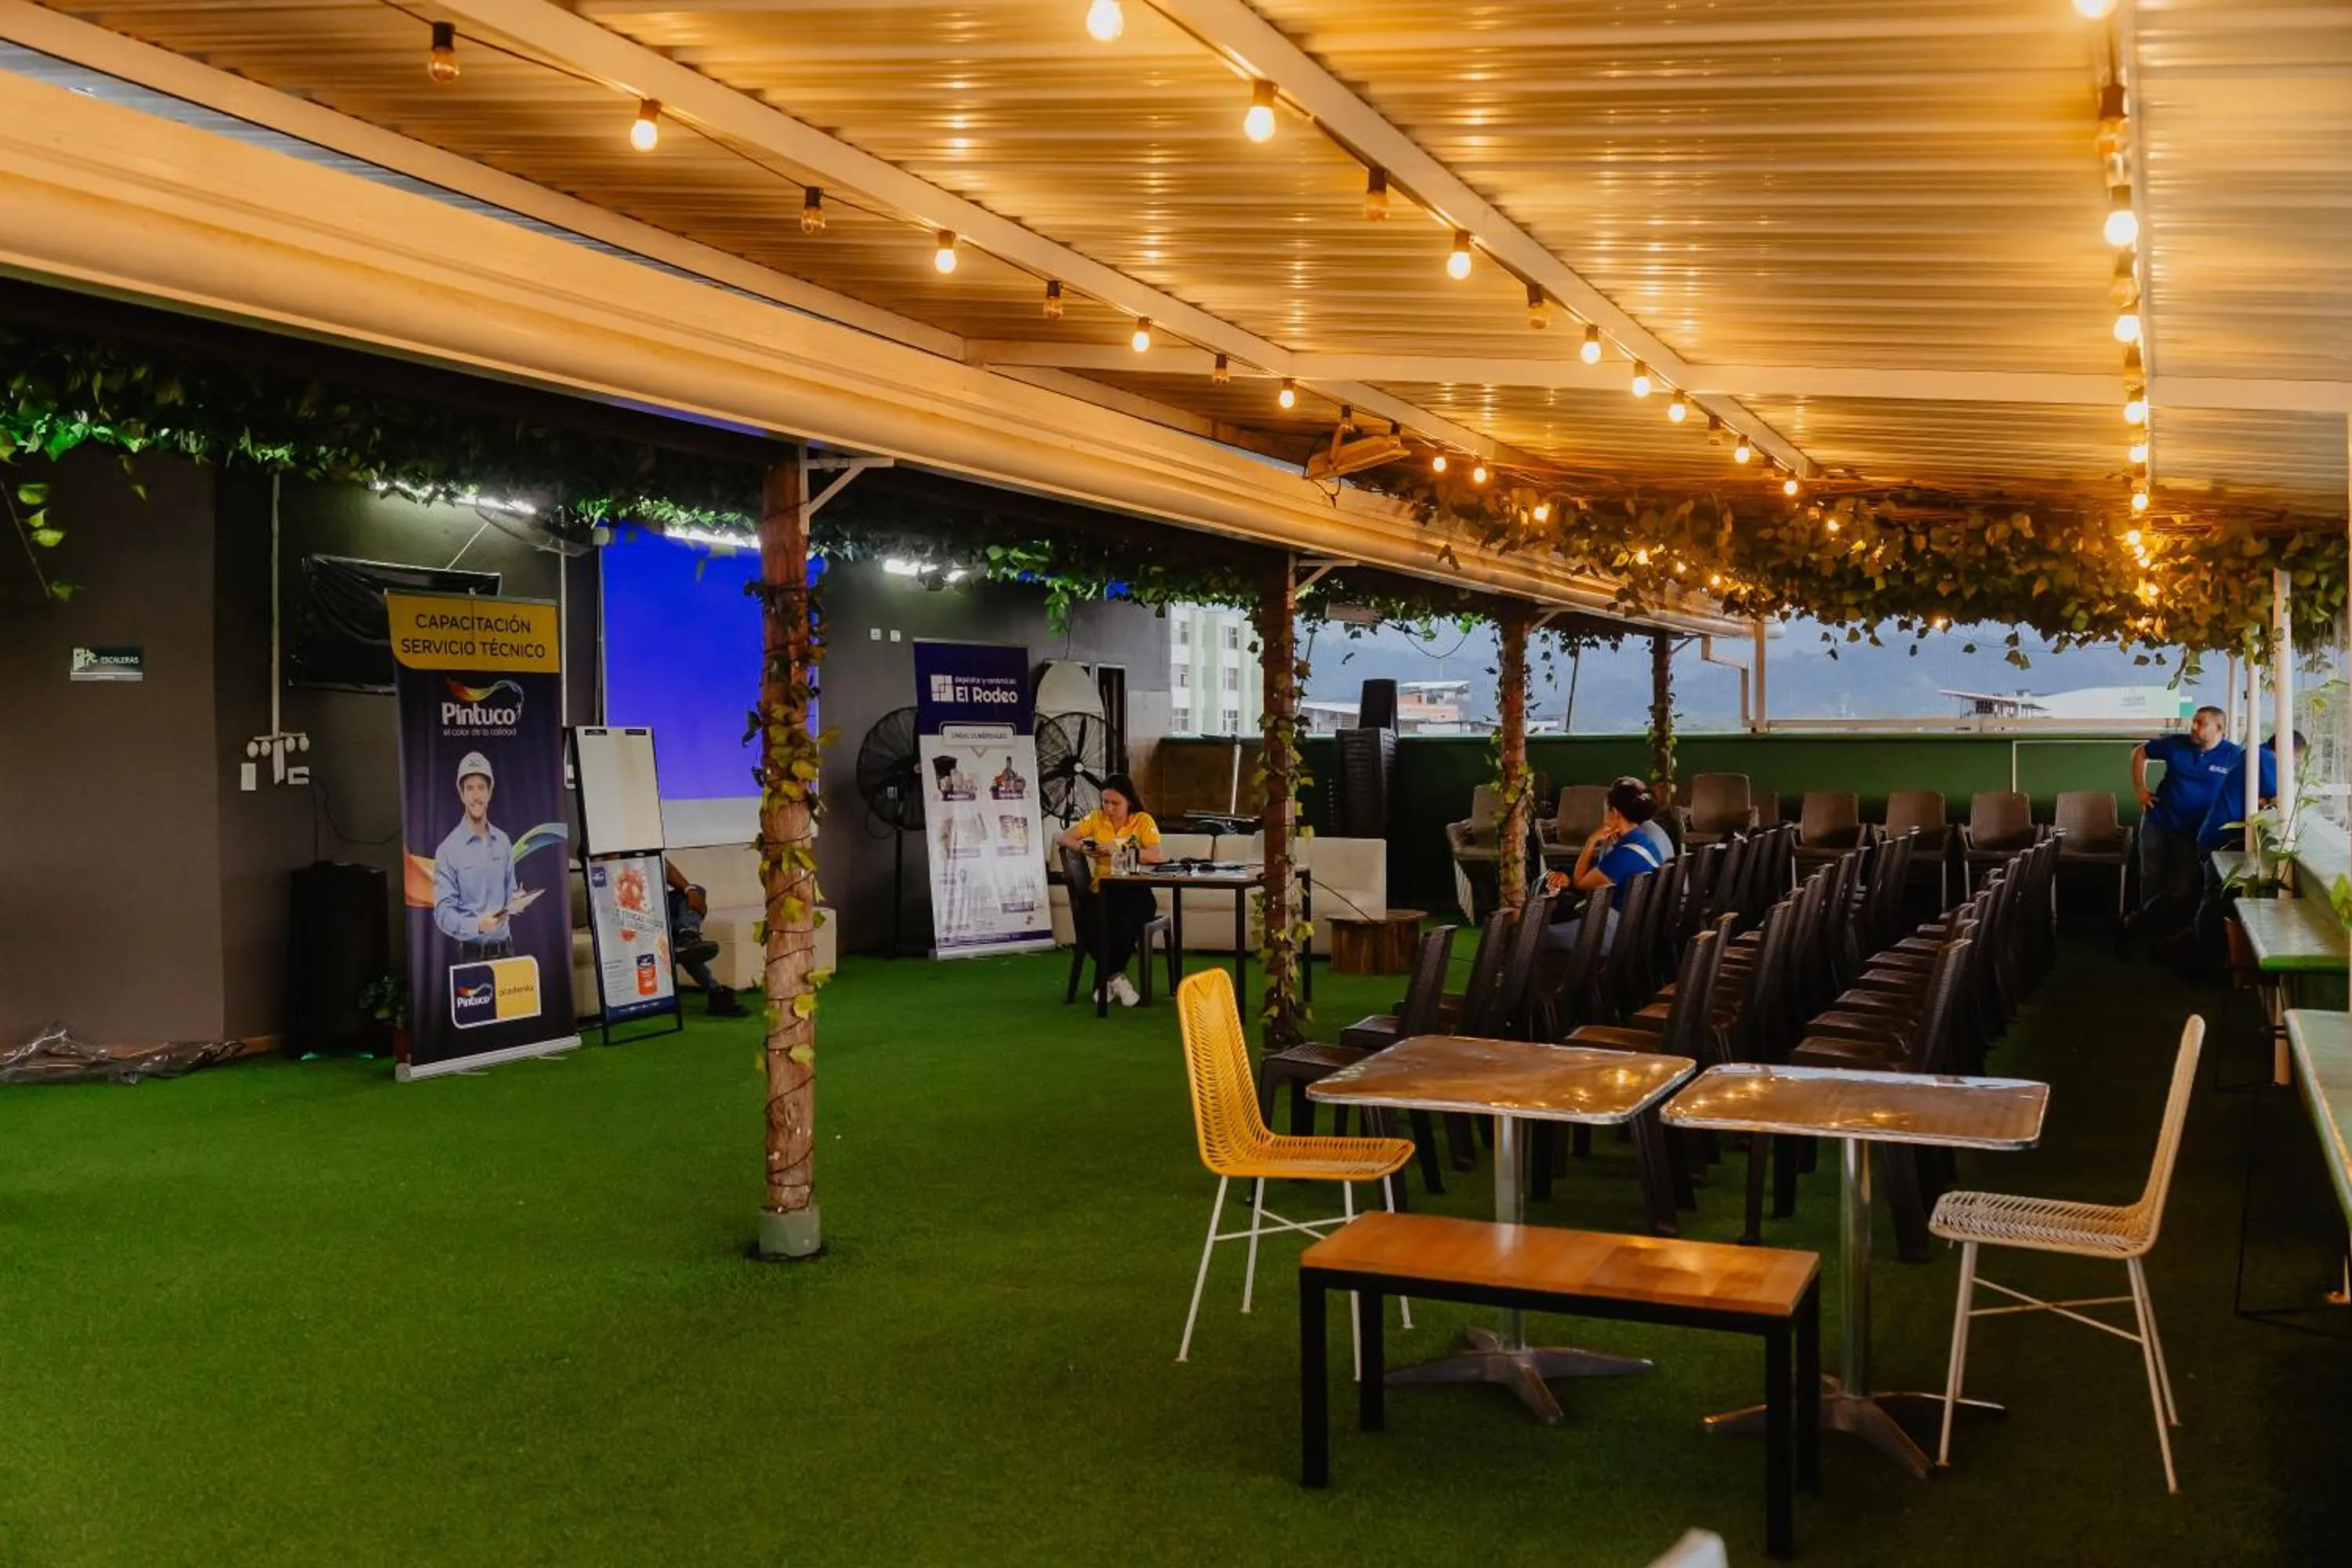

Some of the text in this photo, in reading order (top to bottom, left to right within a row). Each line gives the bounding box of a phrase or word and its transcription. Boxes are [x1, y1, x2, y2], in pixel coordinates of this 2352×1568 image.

[415, 614, 531, 633] CAPACITACIÓN
[401, 637, 546, 659] SERVICIO TÉCNICO
[956, 686, 1018, 703] El Rodeo
[441, 702, 516, 725] Pintuco
[457, 996, 490, 1008] Pintuco
